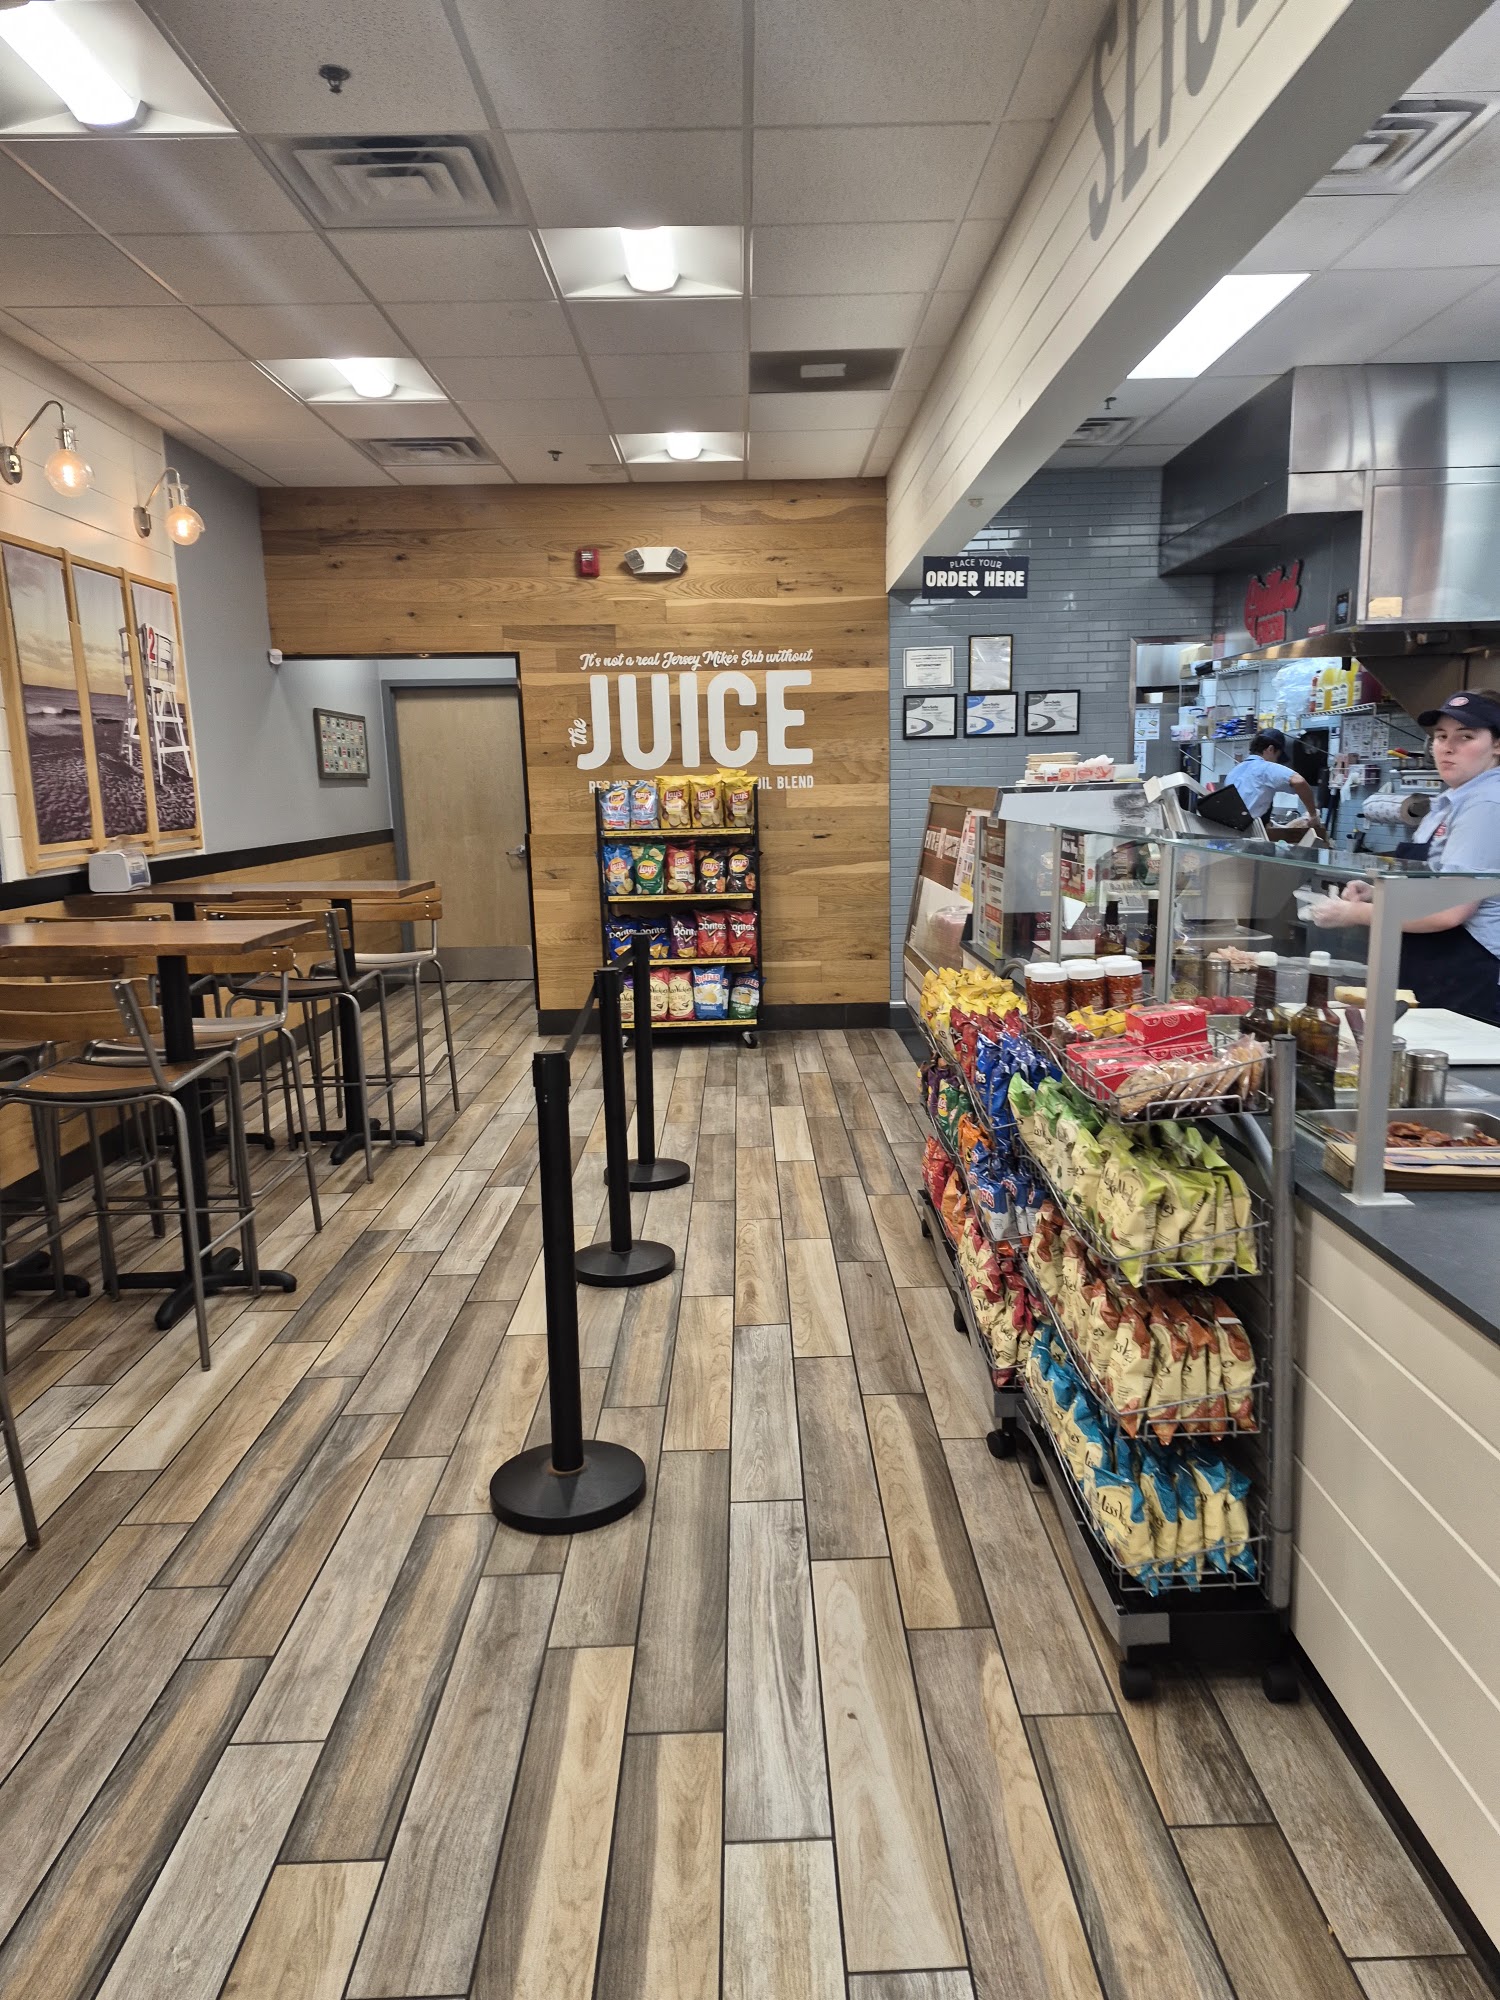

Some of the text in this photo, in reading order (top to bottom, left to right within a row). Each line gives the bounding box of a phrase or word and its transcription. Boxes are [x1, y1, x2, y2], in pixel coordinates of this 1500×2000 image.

[949, 558, 1003, 569] PLACE YOUR
[925, 570, 1026, 588] ORDER HERE
[148, 626, 156, 661] 2
[579, 648, 813, 672] It's not a real Jersey Mike's Sub without
[576, 669, 814, 771] JUICE
[567, 717, 588, 748] the
[776, 775, 814, 790] BLEND
[665, 789, 683, 801] Lay's
[697, 788, 715, 801] Lay's
[732, 791, 749, 804] Lay's
[609, 862, 625, 871] Lay's
[674, 857, 690, 866] Lay's
[702, 862, 718, 872] Lay's
[731, 858, 748, 868] Lay's
[639, 864, 657, 875] Lay's
[731, 923, 755, 931] oritos
